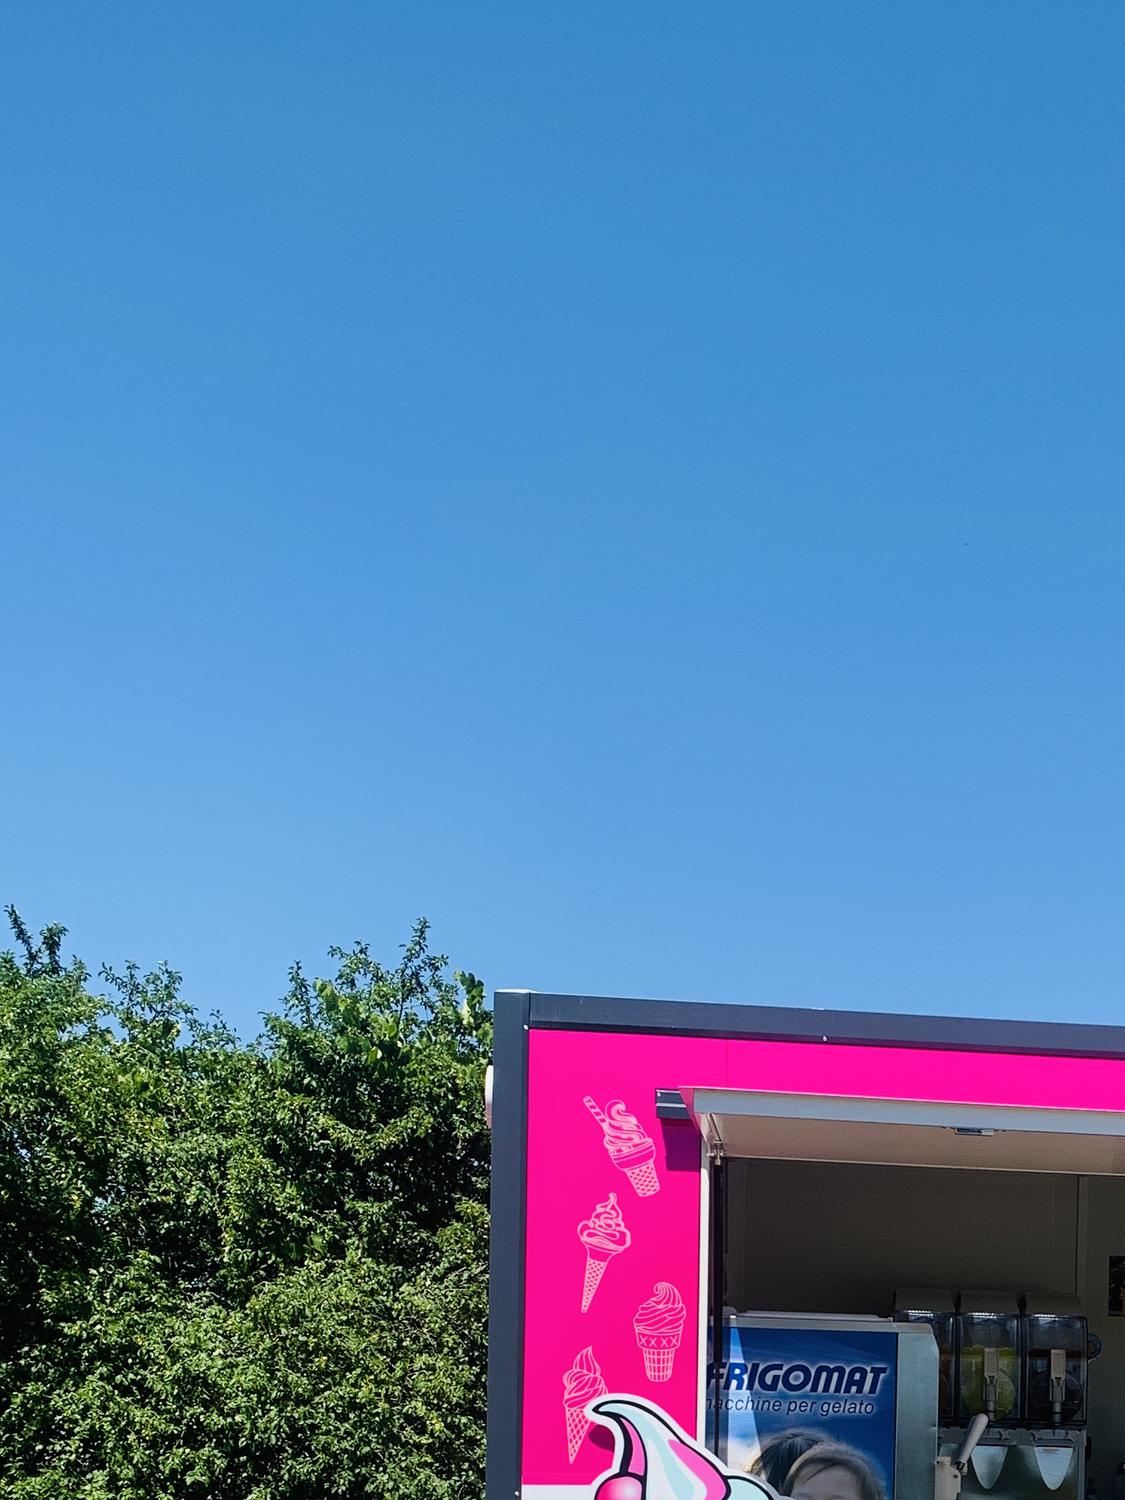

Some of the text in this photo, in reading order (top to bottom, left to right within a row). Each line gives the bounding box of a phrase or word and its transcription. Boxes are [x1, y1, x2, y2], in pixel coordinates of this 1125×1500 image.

[707, 1362, 888, 1395] FRIGOMAT
[786, 1400, 817, 1416] per
[820, 1400, 875, 1417] gelato
